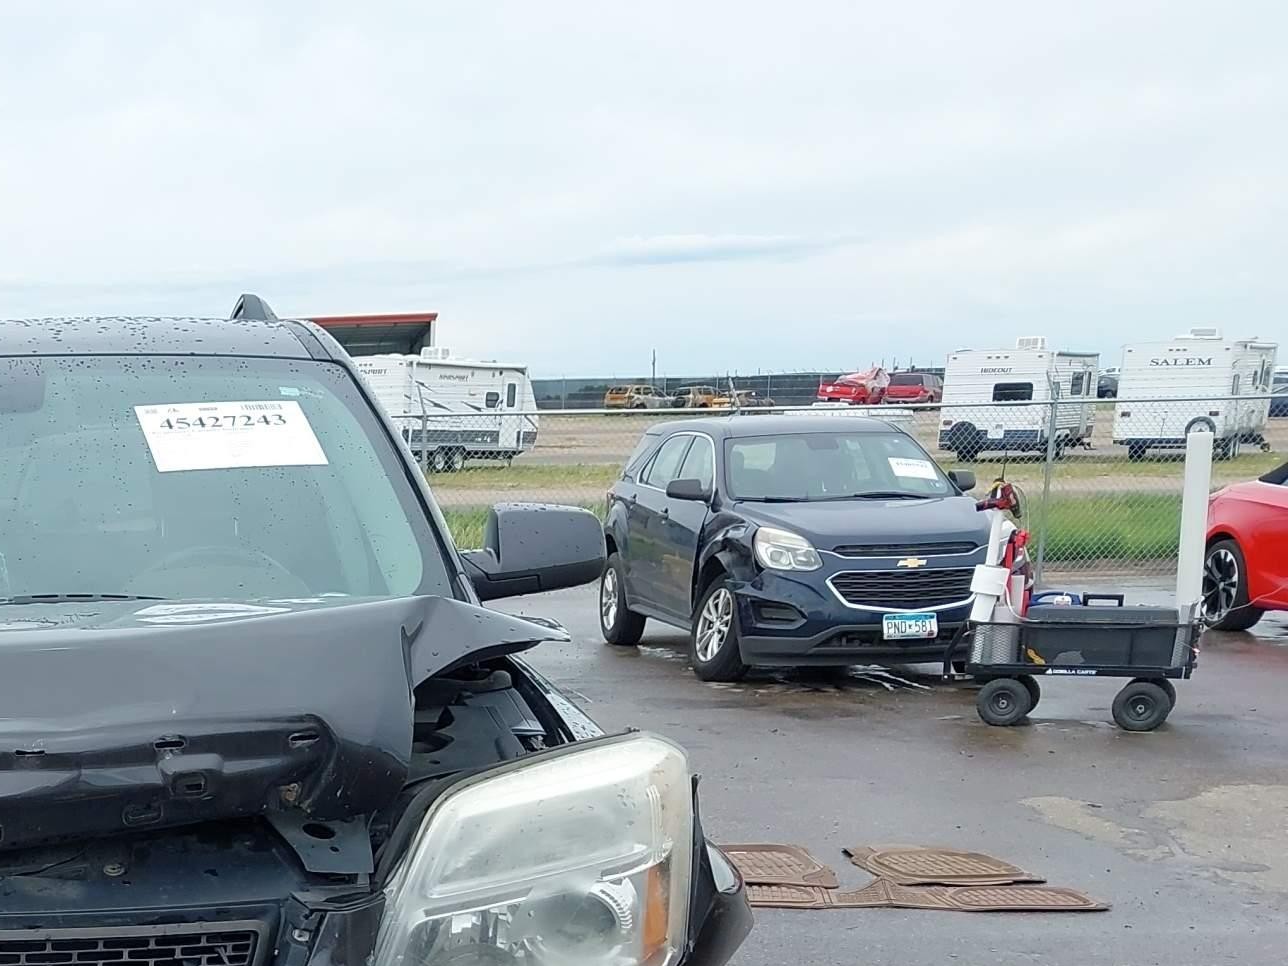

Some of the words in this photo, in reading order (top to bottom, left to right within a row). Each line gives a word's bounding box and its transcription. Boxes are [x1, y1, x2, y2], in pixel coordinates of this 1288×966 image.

[1149, 357, 1214, 367] SALEM
[159, 414, 287, 430] 45427243
[886, 620, 907, 634] PND
[914, 619, 933, 633] 581
